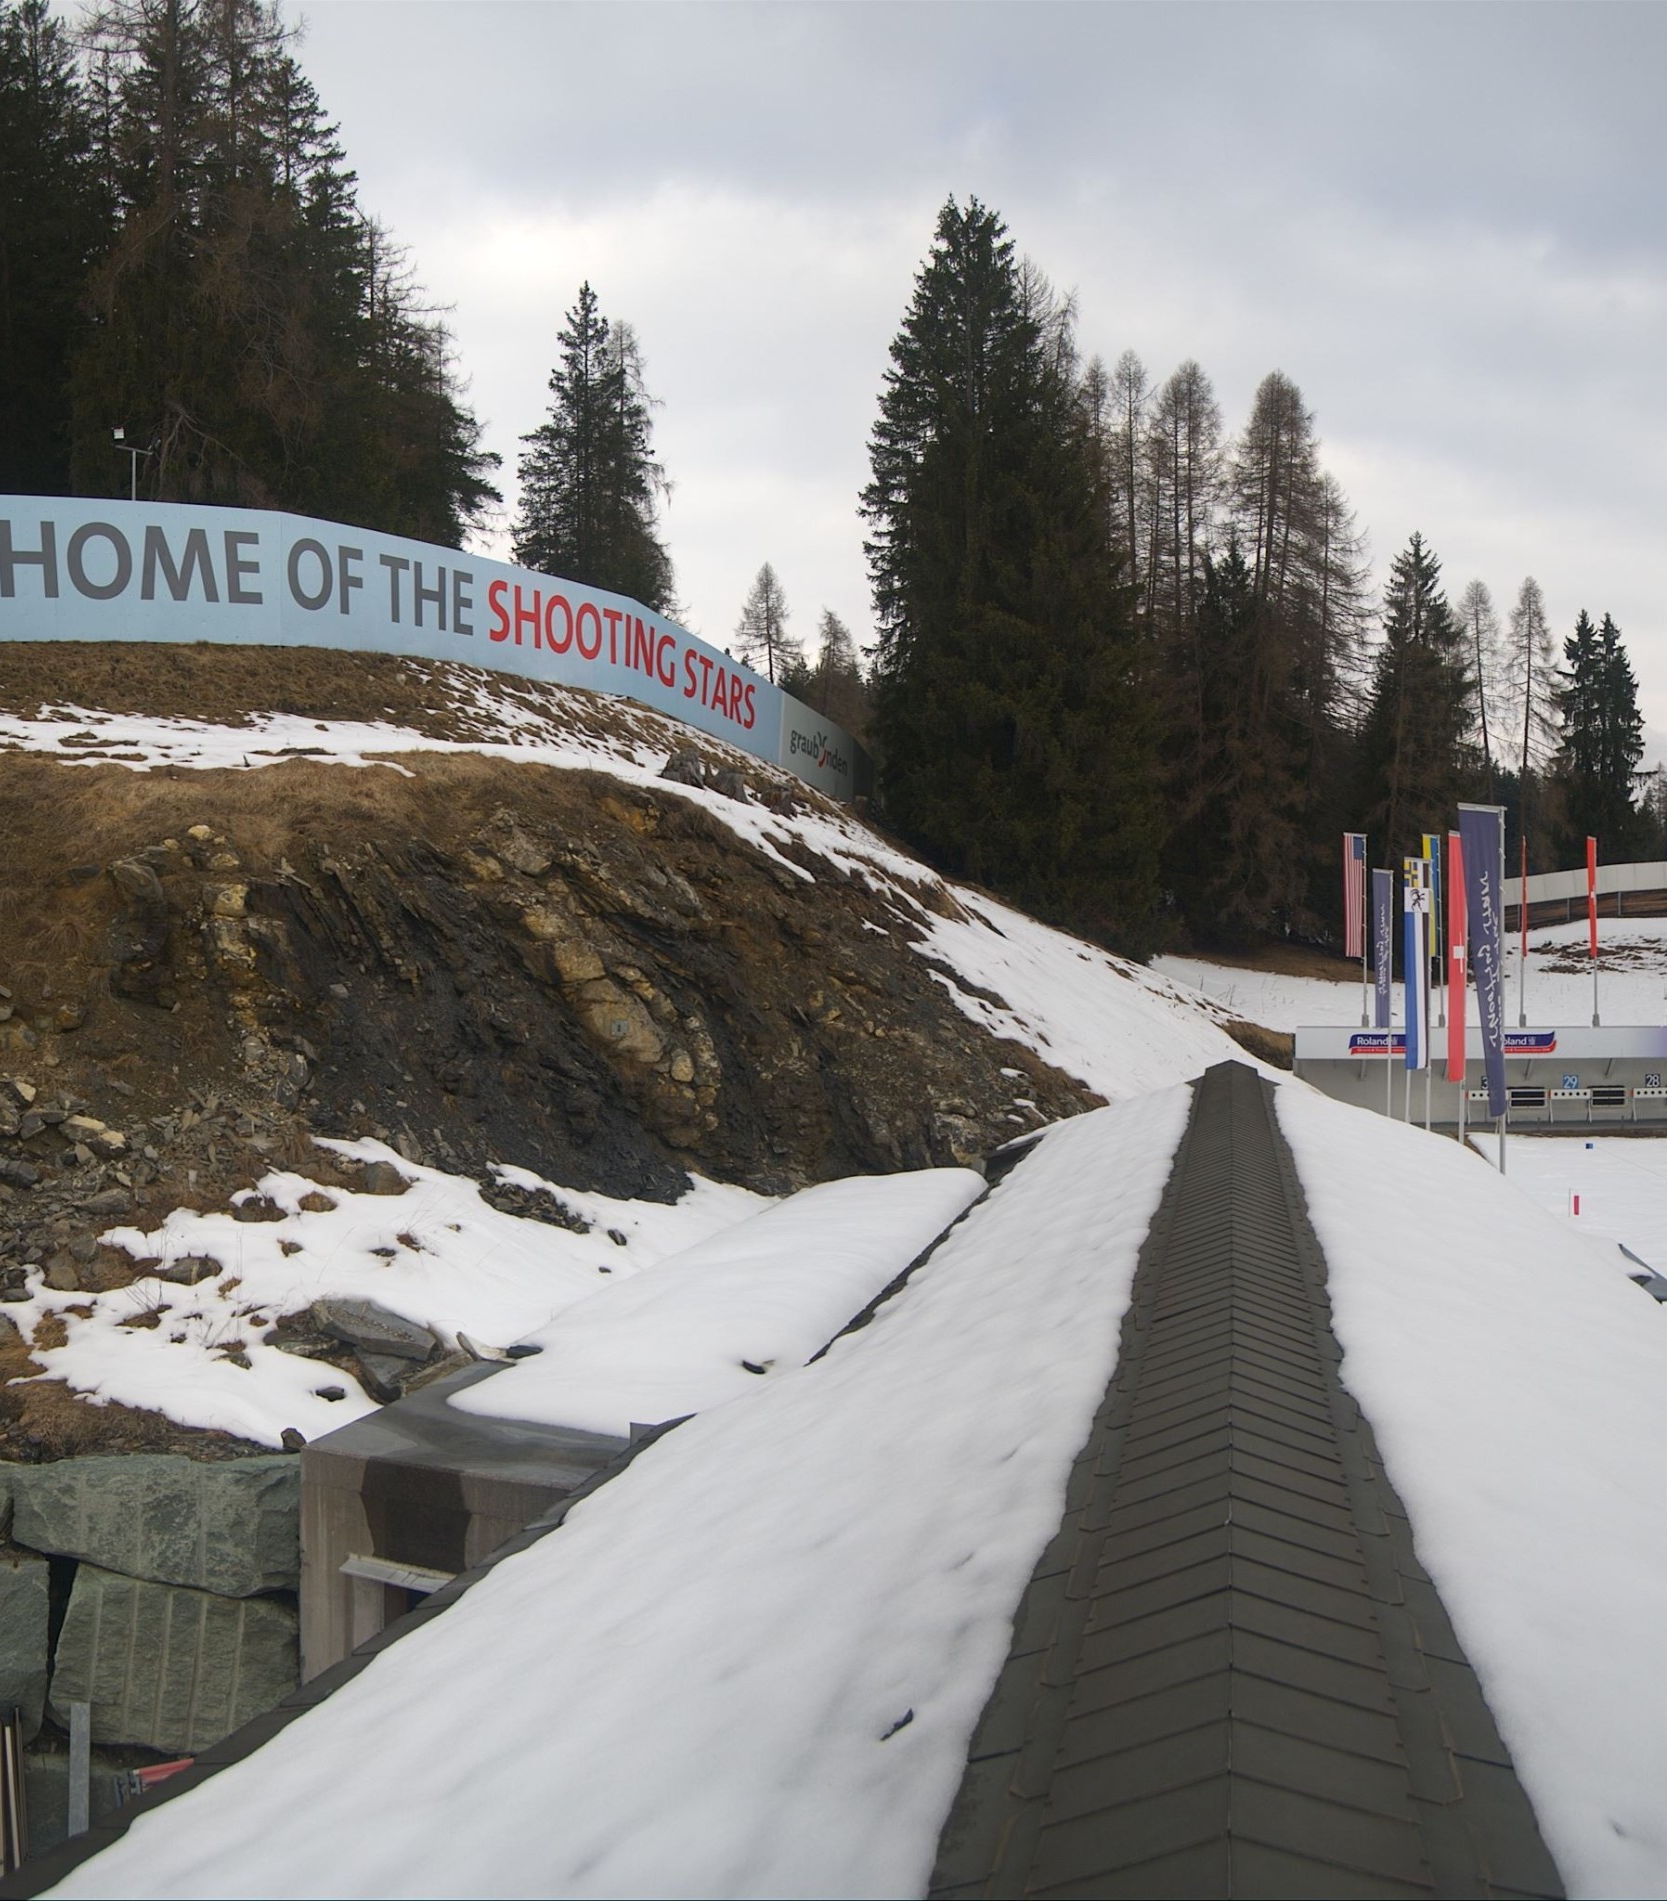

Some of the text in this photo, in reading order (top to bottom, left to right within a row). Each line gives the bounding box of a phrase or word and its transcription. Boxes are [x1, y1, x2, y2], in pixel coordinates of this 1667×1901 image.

[287, 537, 365, 615] OF
[379, 553, 475, 637] THE
[487, 579, 677, 689] SHOOTING
[683, 648, 757, 730] STARS
[1357, 1036, 1389, 1046] Roland
[1503, 1036, 1526, 1046] oland
[1482, 1077, 1489, 1089] 3
[1563, 1076, 1578, 1088] 29
[1646, 1074, 1660, 1087] 28
